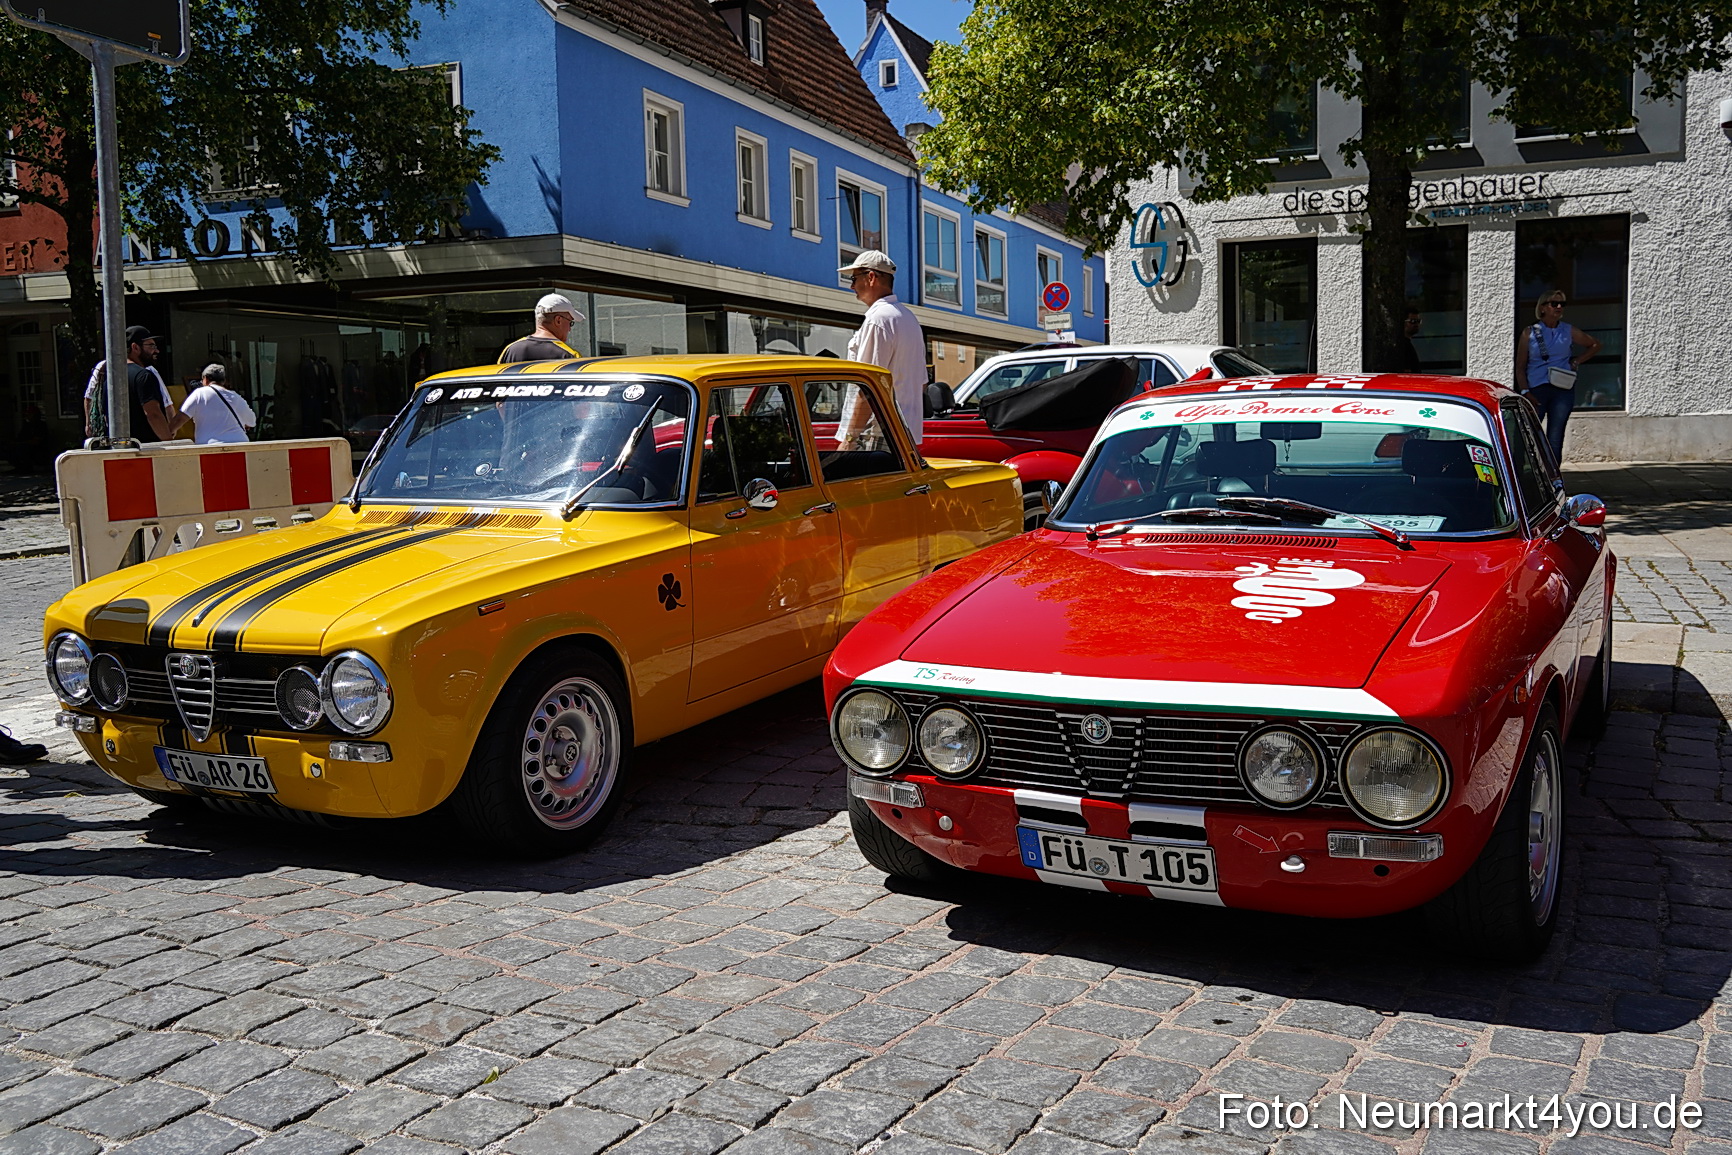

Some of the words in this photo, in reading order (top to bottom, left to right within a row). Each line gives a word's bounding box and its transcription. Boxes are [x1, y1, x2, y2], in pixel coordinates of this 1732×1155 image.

[1283, 187, 1324, 212] die
[1332, 173, 1549, 212] spgenbauer
[450, 388, 483, 400] ATB
[491, 385, 554, 398] RACING
[564, 385, 612, 397] CLUB
[1175, 404, 1235, 422] Alfa
[1237, 401, 1330, 415] Romeo
[1332, 401, 1395, 415] Corse
[1381, 519, 1420, 528] 295
[913, 667, 939, 680] TS
[937, 672, 976, 684] Racing
[167, 753, 198, 782] FÜ
[207, 759, 238, 787] AR
[236, 762, 268, 789] 26
[1028, 851, 1036, 860] D
[1042, 835, 1088, 872] FÜ
[1108, 844, 1129, 877] T
[1139, 849, 1209, 885] 105
